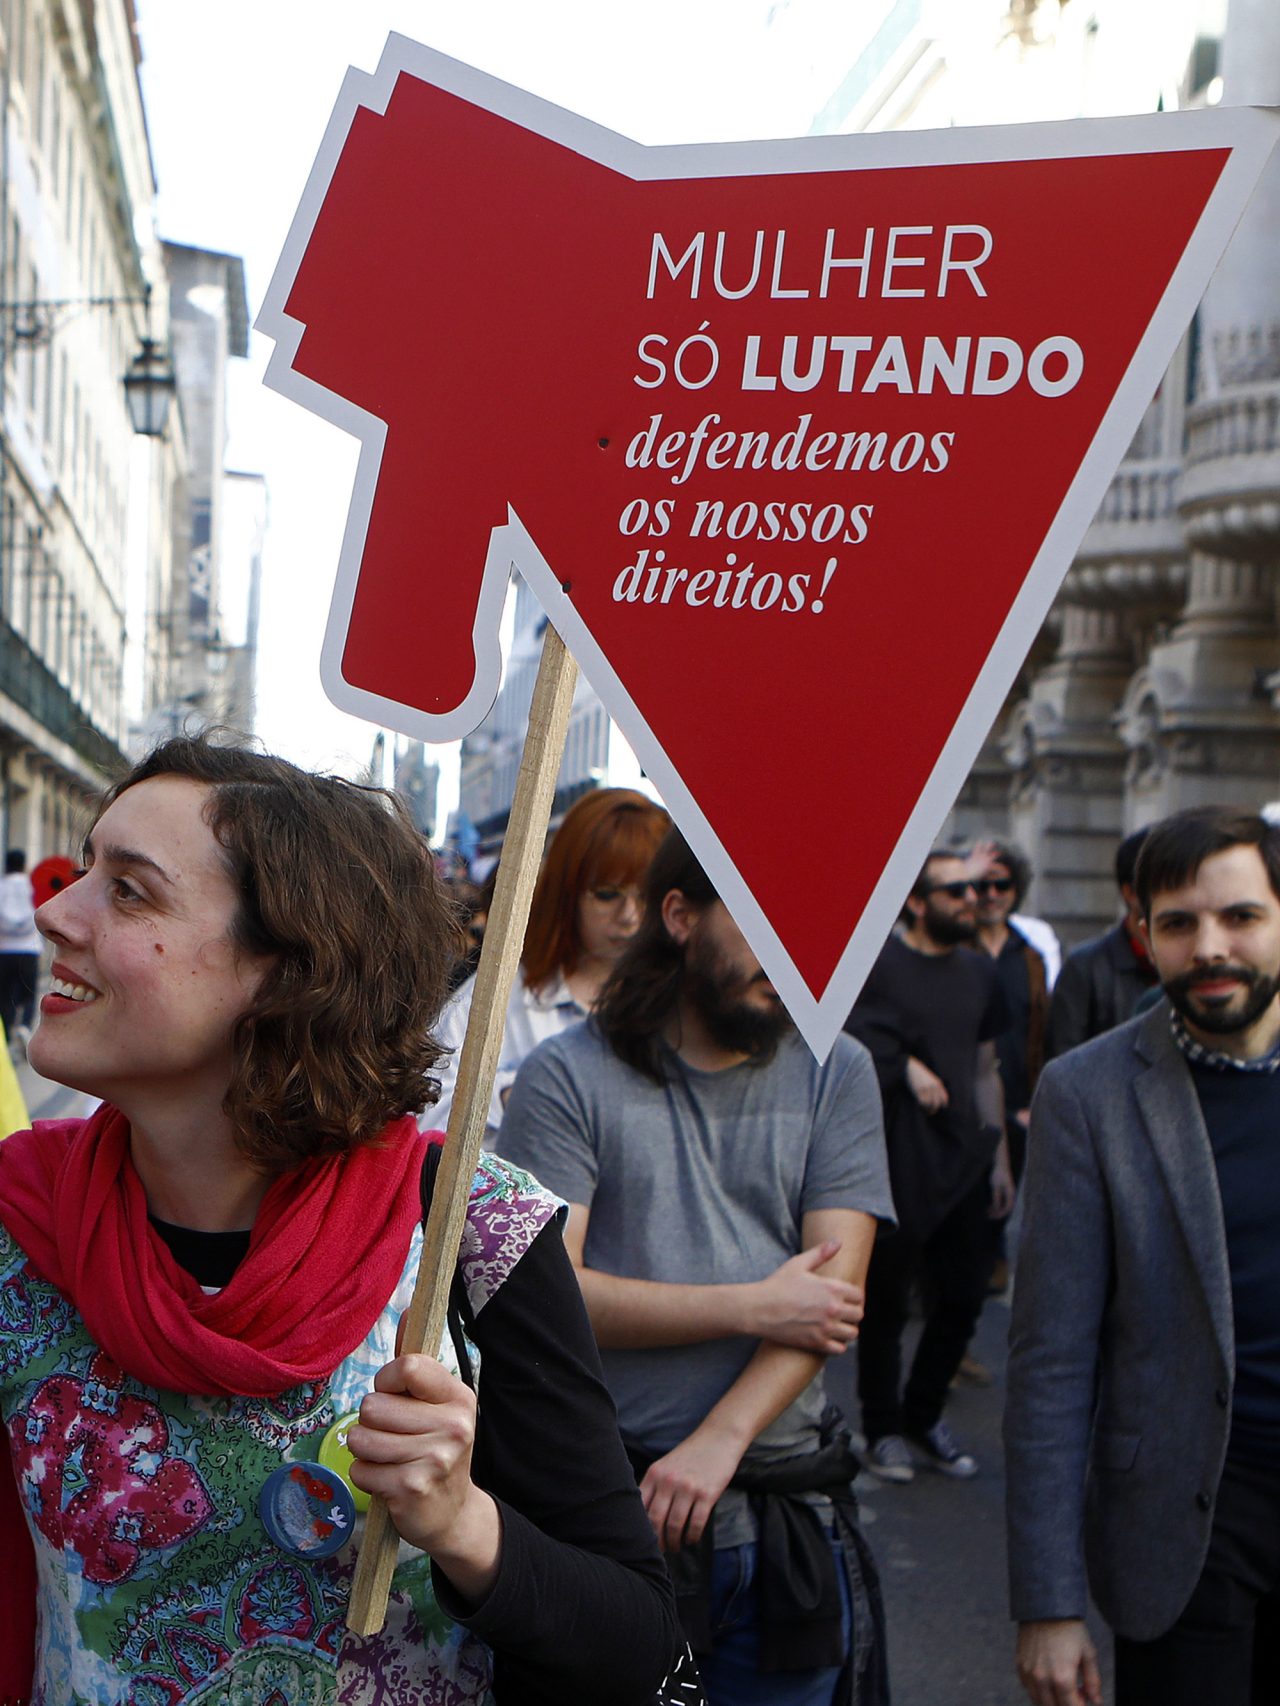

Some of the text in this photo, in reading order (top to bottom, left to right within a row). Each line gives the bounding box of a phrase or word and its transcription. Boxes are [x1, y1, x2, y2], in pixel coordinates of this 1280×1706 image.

[646, 225, 993, 299] MULHER
[633, 321, 1084, 398] SÓ LUTANDO
[625, 413, 956, 484] defendemos
[619, 498, 874, 544] os nossos
[612, 549, 838, 614] direitos!
